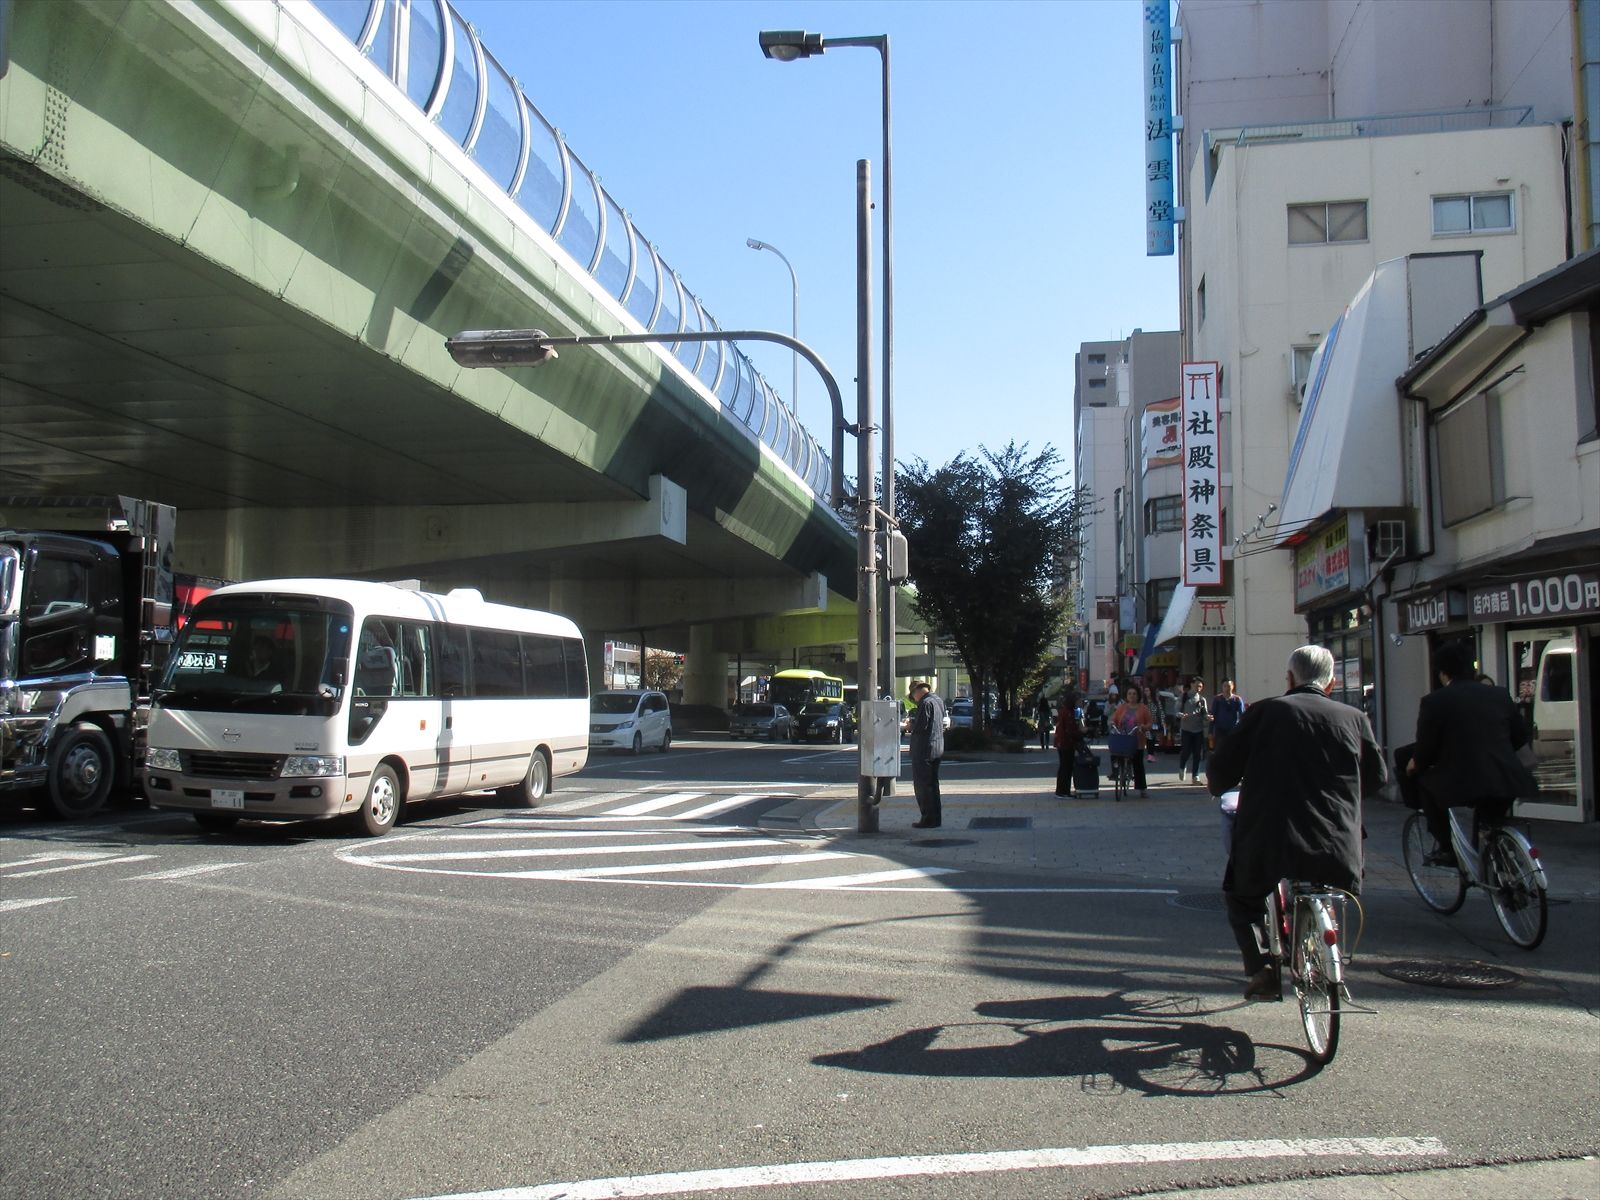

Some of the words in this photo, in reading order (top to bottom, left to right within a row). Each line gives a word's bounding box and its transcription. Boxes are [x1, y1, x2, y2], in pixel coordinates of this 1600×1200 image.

[1150, 29, 1164, 89] 仏壇・仏具
[1146, 119, 1171, 223] 法雲堂
[1187, 410, 1218, 573] 社殿神祭具
[1473, 591, 1510, 615] 店内商品
[1511, 574, 1600, 616] 1,000円
